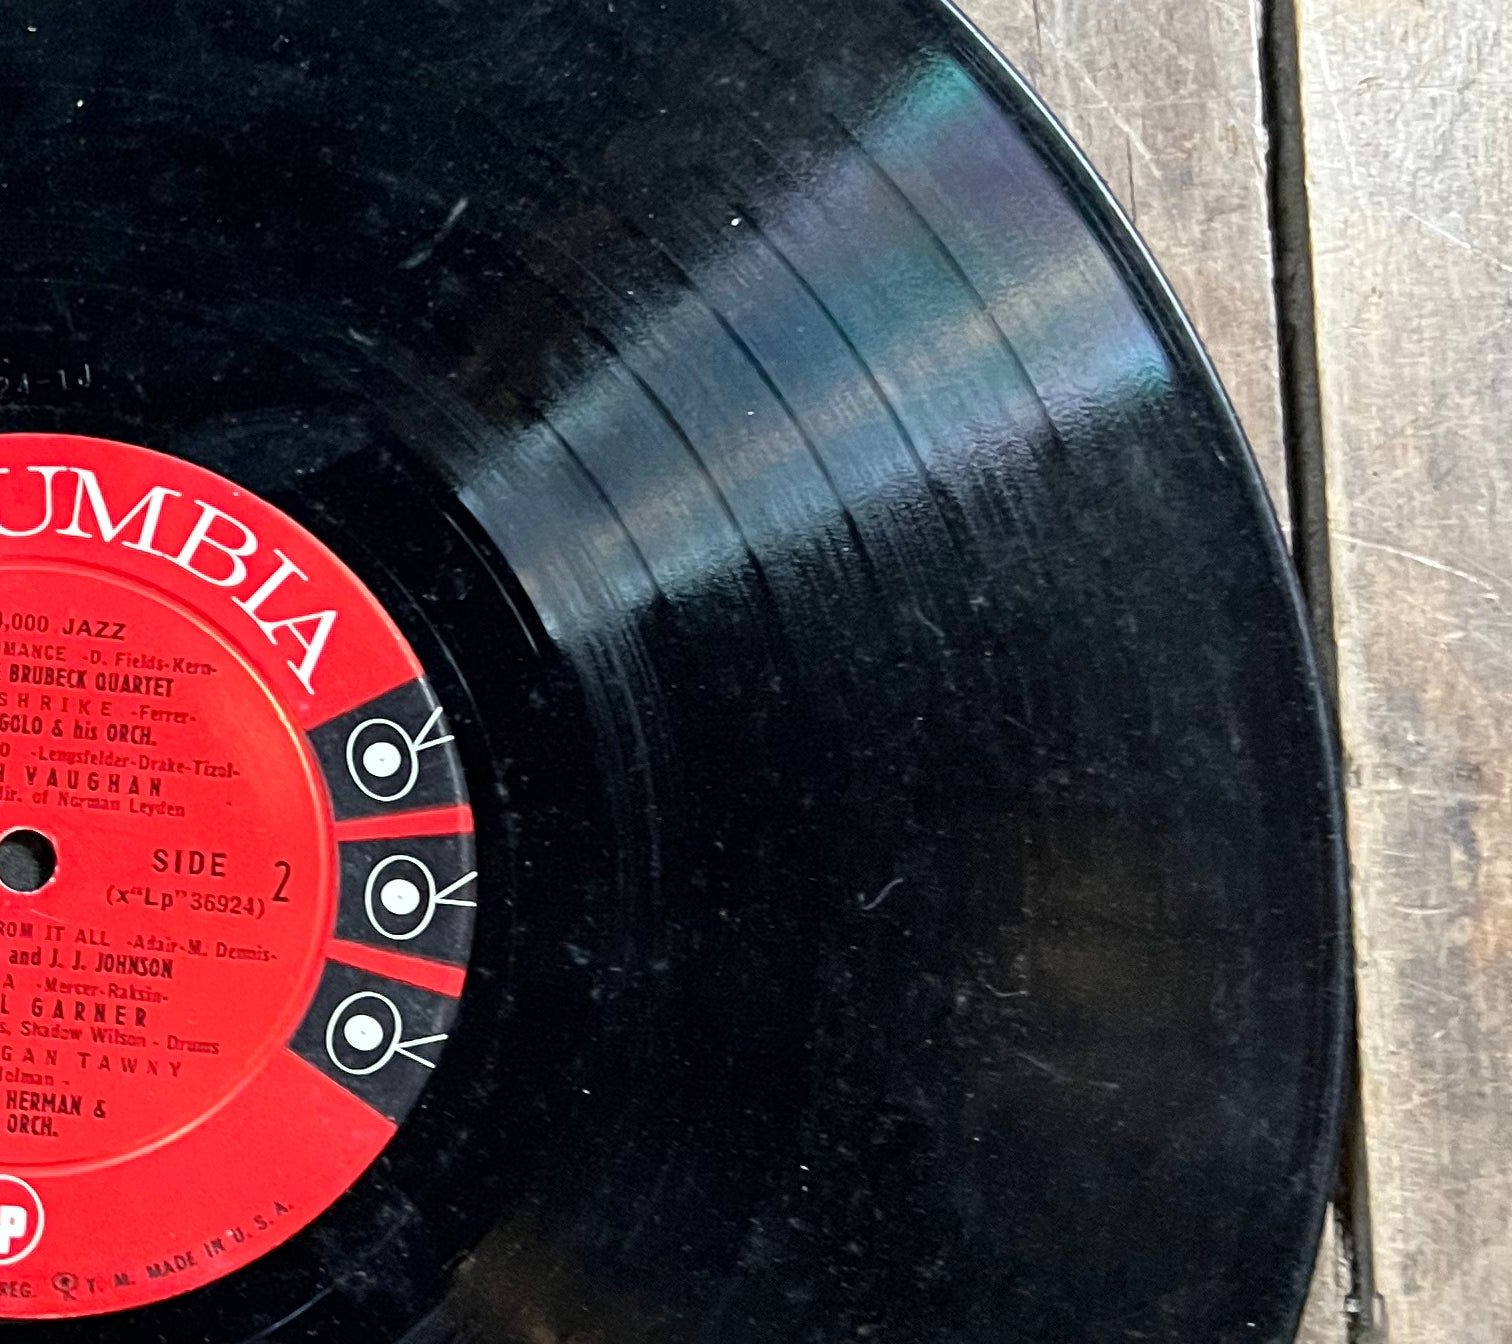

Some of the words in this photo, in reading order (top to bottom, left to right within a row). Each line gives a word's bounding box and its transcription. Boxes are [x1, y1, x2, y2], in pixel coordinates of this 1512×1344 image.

[62, 618, 127, 641] JAZZ
[9, 664, 88, 690] BRUBECK
[95, 672, 174, 697] QUARTET
[51, 718, 64, 737] &
[73, 719, 98, 741] his
[106, 723, 158, 747] ORCH.
[25, 764, 162, 797] VAUGHAN
[32, 789, 49, 805] of
[58, 790, 121, 811] Norman
[129, 798, 185, 817] Leyden
[152, 848, 228, 878] SIDE
[271, 860, 292, 903] 2
[44, 924, 65, 942] IT
[75, 928, 111, 947] ALL
[8, 946, 42, 966] and
[49, 948, 65, 968] J.
[71, 950, 87, 971] J.
[94, 952, 173, 979] JOHNSON
[31, 997, 147, 1027] GARNER
[20, 1020, 83, 1041] Shadow
[90, 1026, 146, 1048] Wilson
[166, 1034, 220, 1055] Drums
[77, 1051, 181, 1078] TAWNY
[6, 1090, 82, 1116] HERMAN
[93, 1099, 107, 1119] &
[6, 1113, 59, 1137] ORCH.
[145, 1251, 198, 1280] MADE
[204, 1238, 226, 1258] IN
